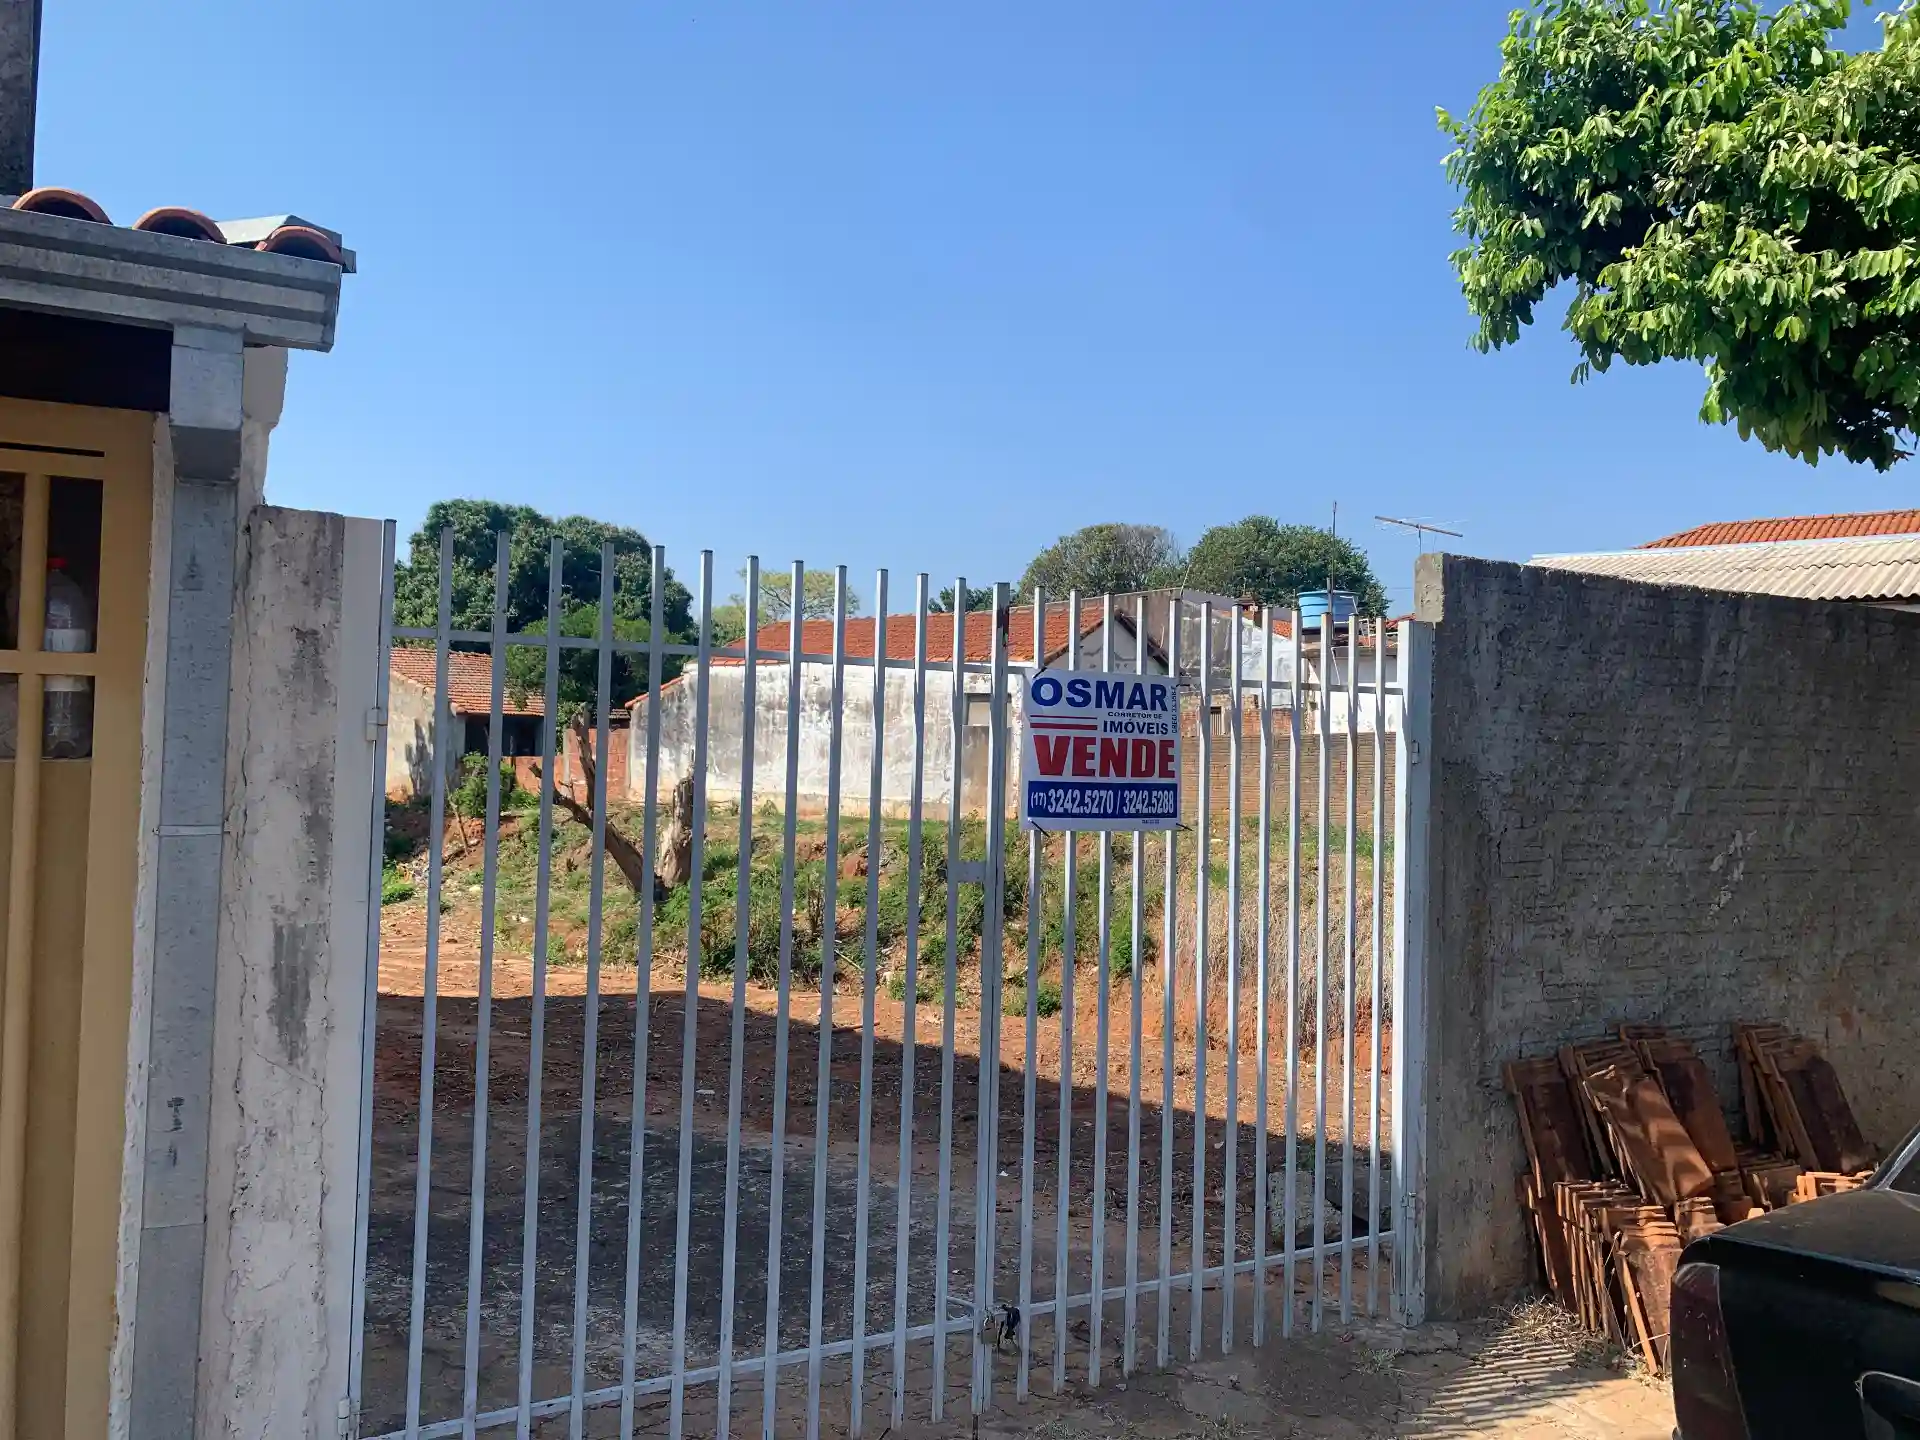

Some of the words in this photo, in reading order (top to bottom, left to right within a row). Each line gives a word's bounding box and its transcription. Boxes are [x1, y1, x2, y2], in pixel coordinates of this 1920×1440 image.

[1031, 677, 1168, 712] OSMAR
[1103, 719, 1169, 735] IMÓVEIS
[1107, 711, 1151, 719] CORRETOR
[1033, 735, 1175, 778] VENDE
[1030, 792, 1047, 809] (17)
[1048, 788, 1114, 814] 3242.5270
[1123, 790, 1174, 814] 3242.5288
